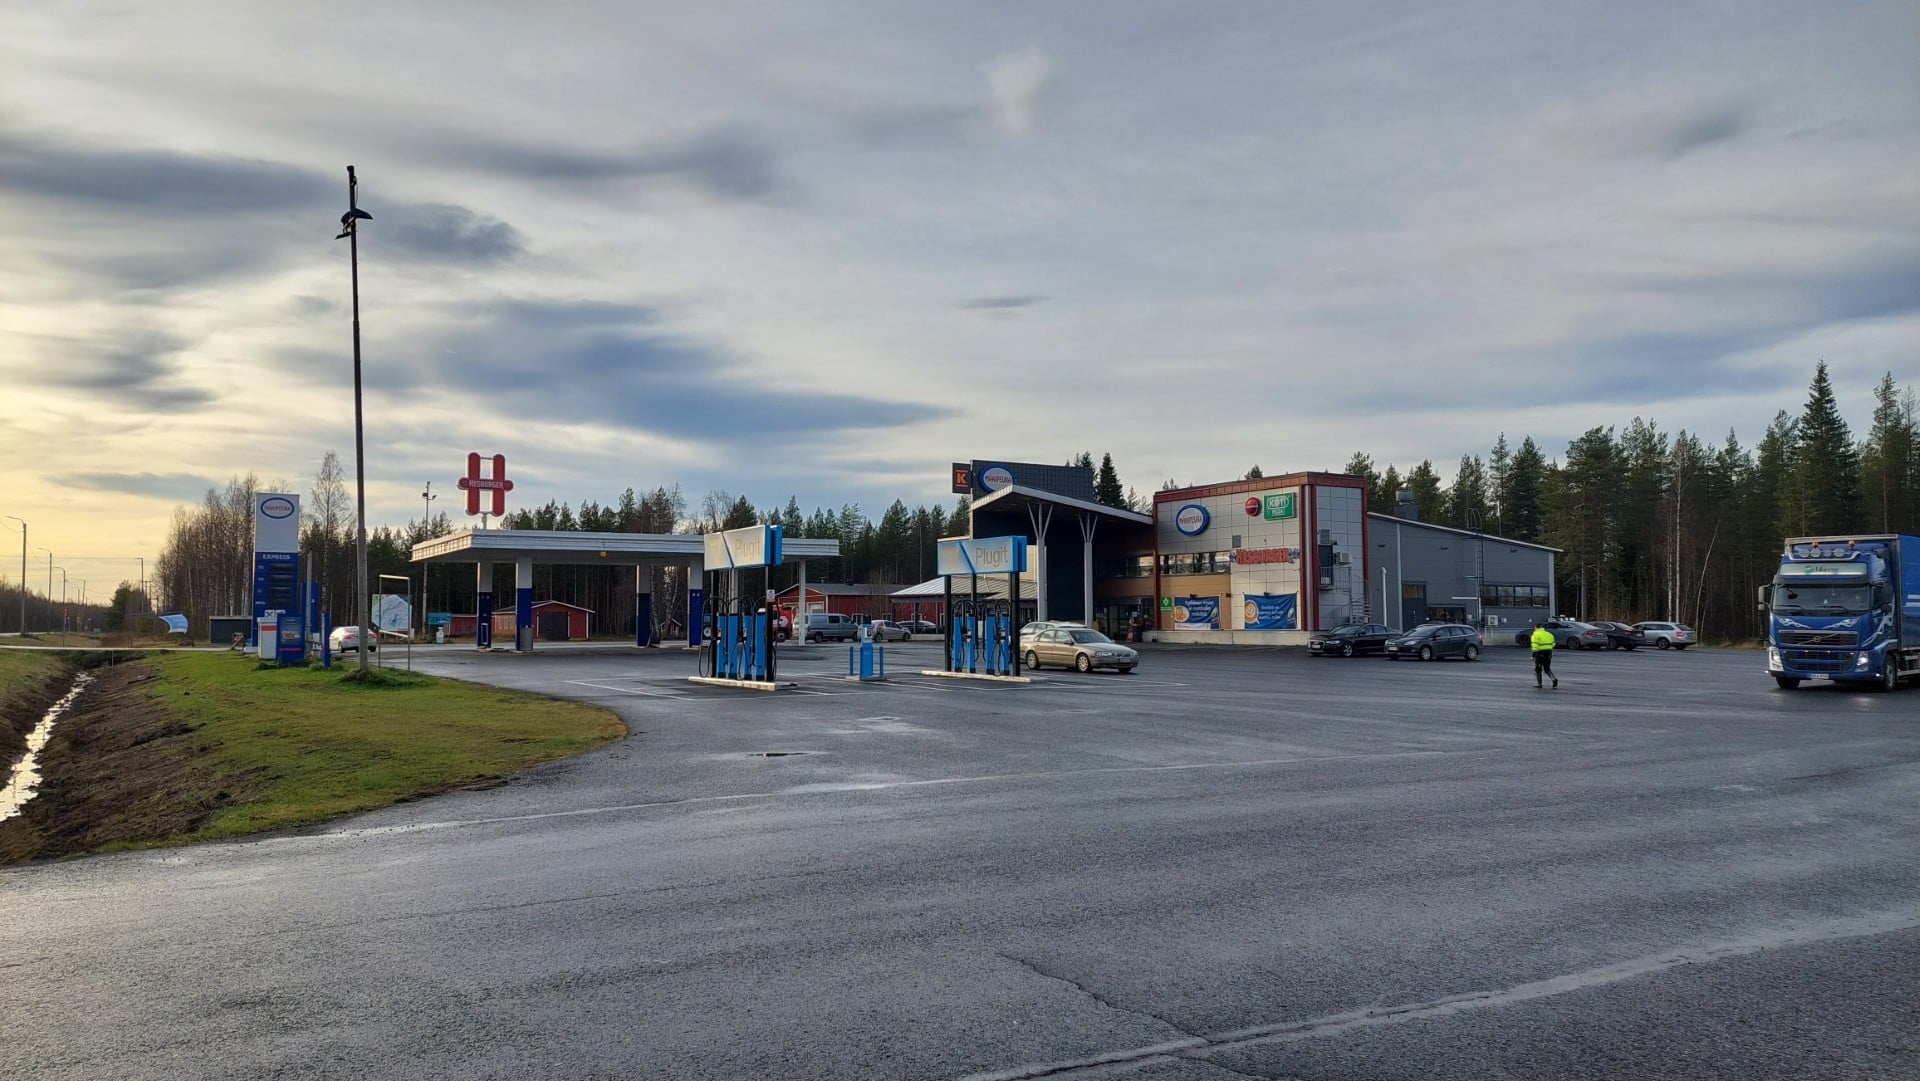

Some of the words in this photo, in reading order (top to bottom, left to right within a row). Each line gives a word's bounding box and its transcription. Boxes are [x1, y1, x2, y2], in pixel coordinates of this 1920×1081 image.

[469, 480, 504, 489] HESBURGER
[956, 472, 967, 484] K
[735, 536, 761, 559] Plugit
[975, 545, 1008, 568] Plugit
[1236, 548, 1288, 565] HESBURGER
